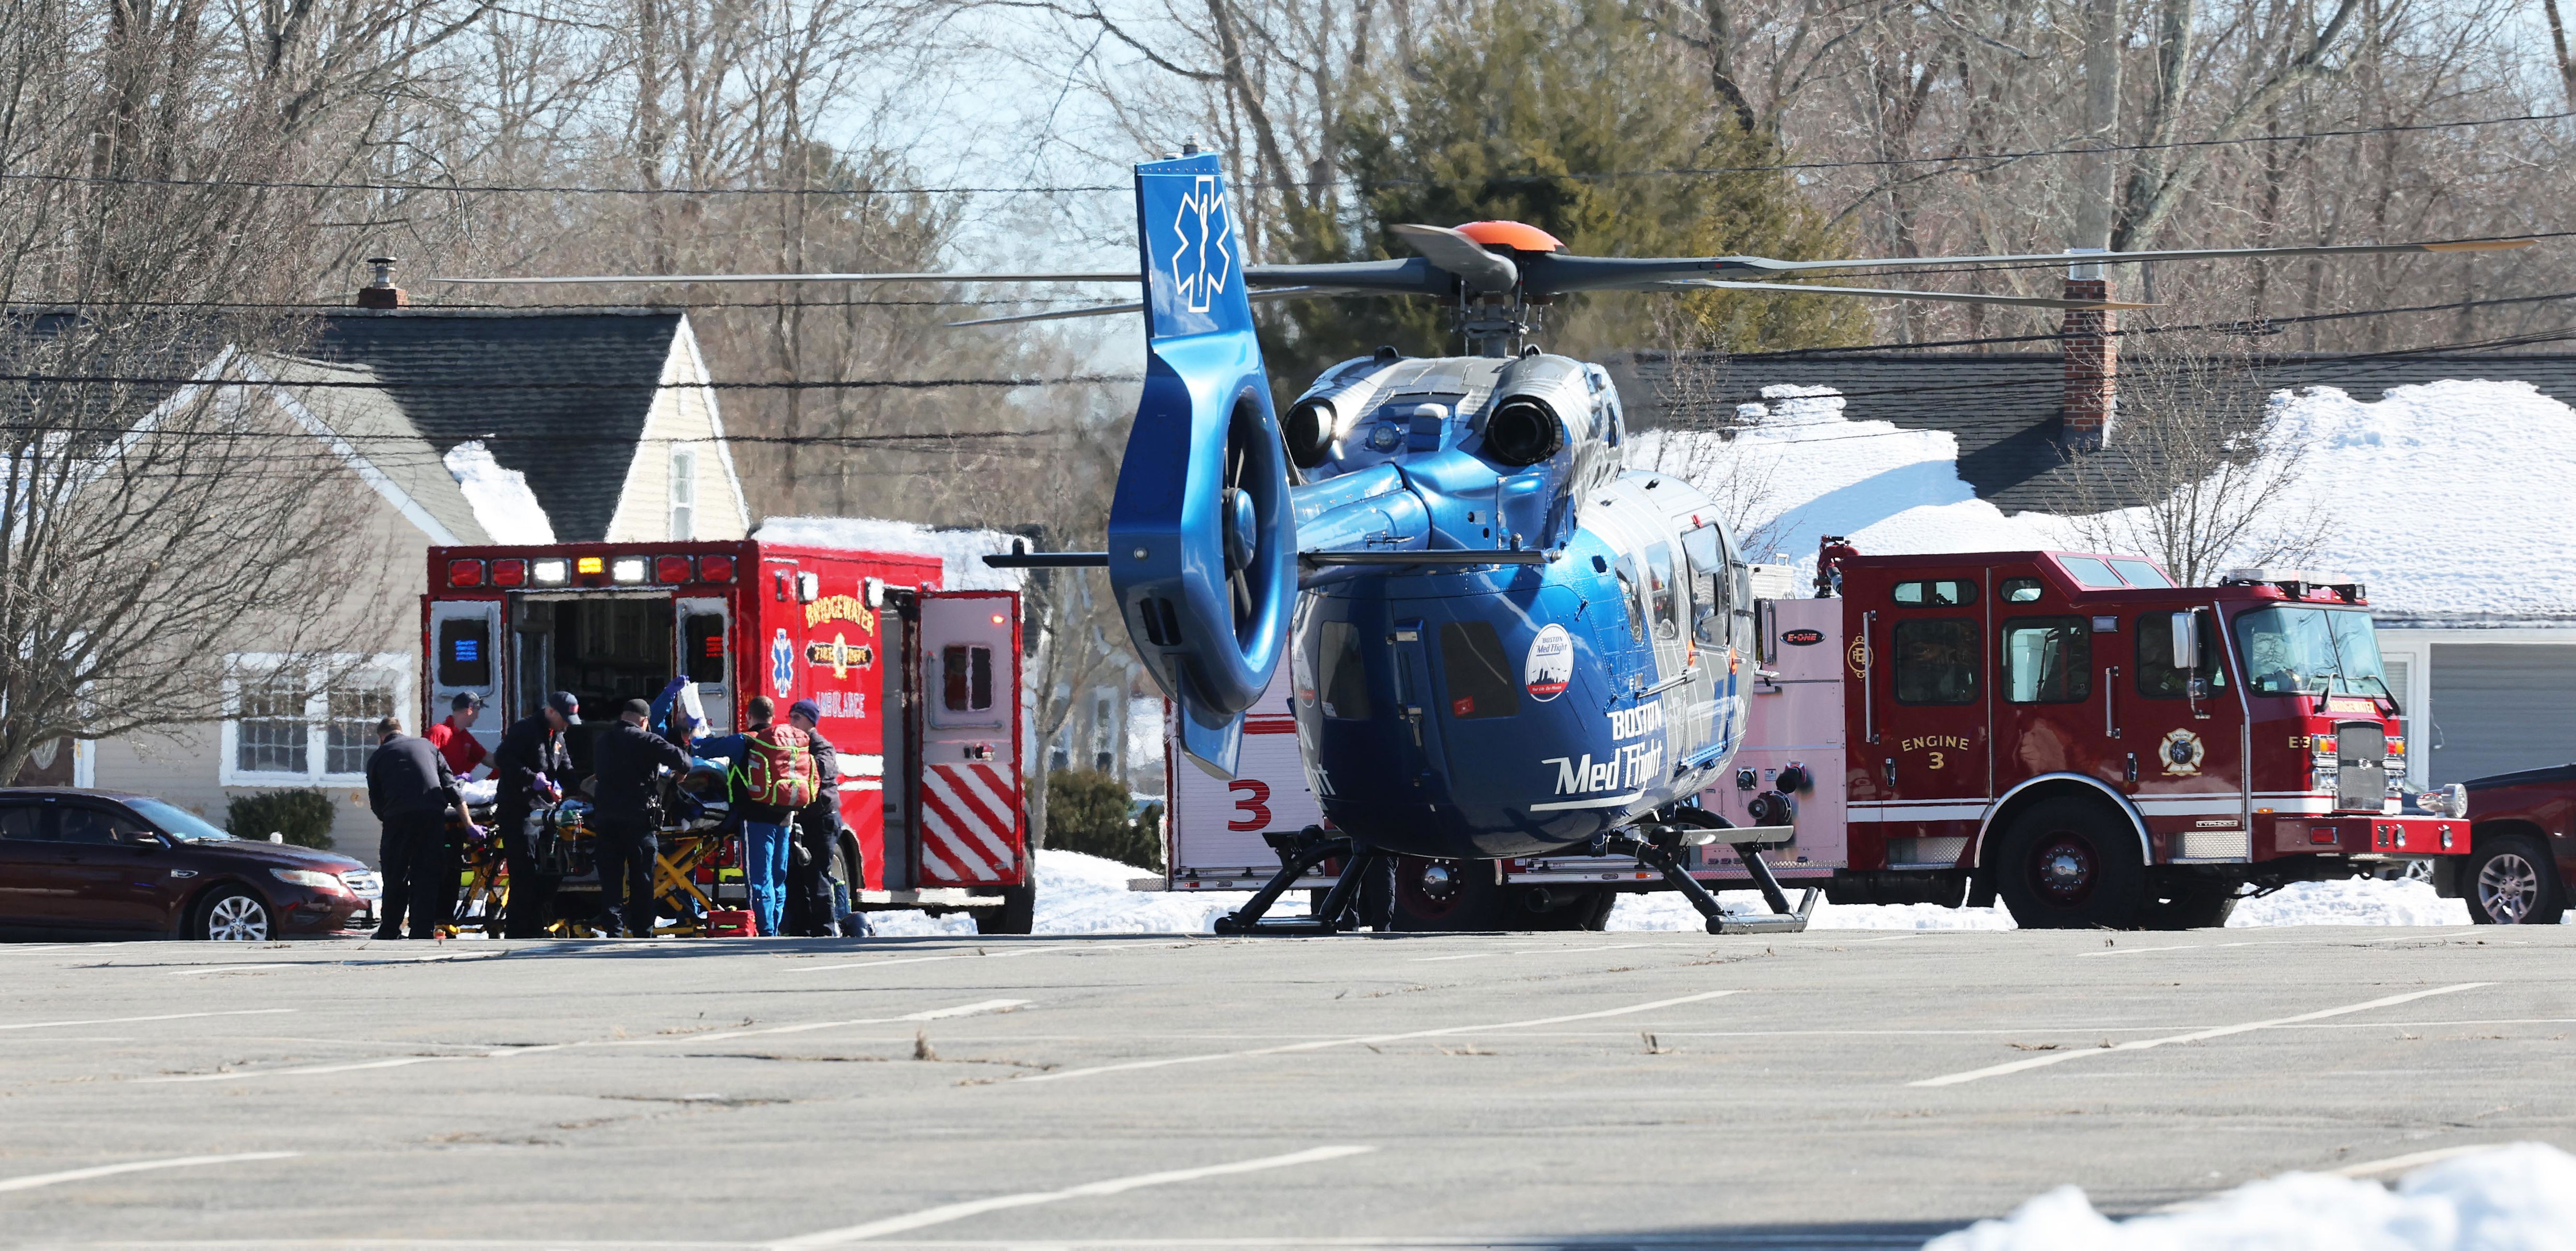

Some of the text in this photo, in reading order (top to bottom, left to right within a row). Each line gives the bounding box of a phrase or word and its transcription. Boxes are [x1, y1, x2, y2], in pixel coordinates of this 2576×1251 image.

[805, 594, 874, 637] BRIDGEWATER
[1787, 633, 1817, 641] E-ONE
[814, 646, 834, 661] FIRE
[1536, 644, 1567, 654] Med Flight
[816, 691, 866, 718] AMBULANCE
[2328, 700, 2376, 714] BRIDGEWATER
[1607, 699, 1663, 740] BOSTON
[1901, 735, 1970, 752] ENGINE
[1541, 748, 1620, 795] Med
[1622, 738, 1663, 790] Flight
[1929, 752, 1944, 769] 3
[1228, 779, 1271, 831] 3
